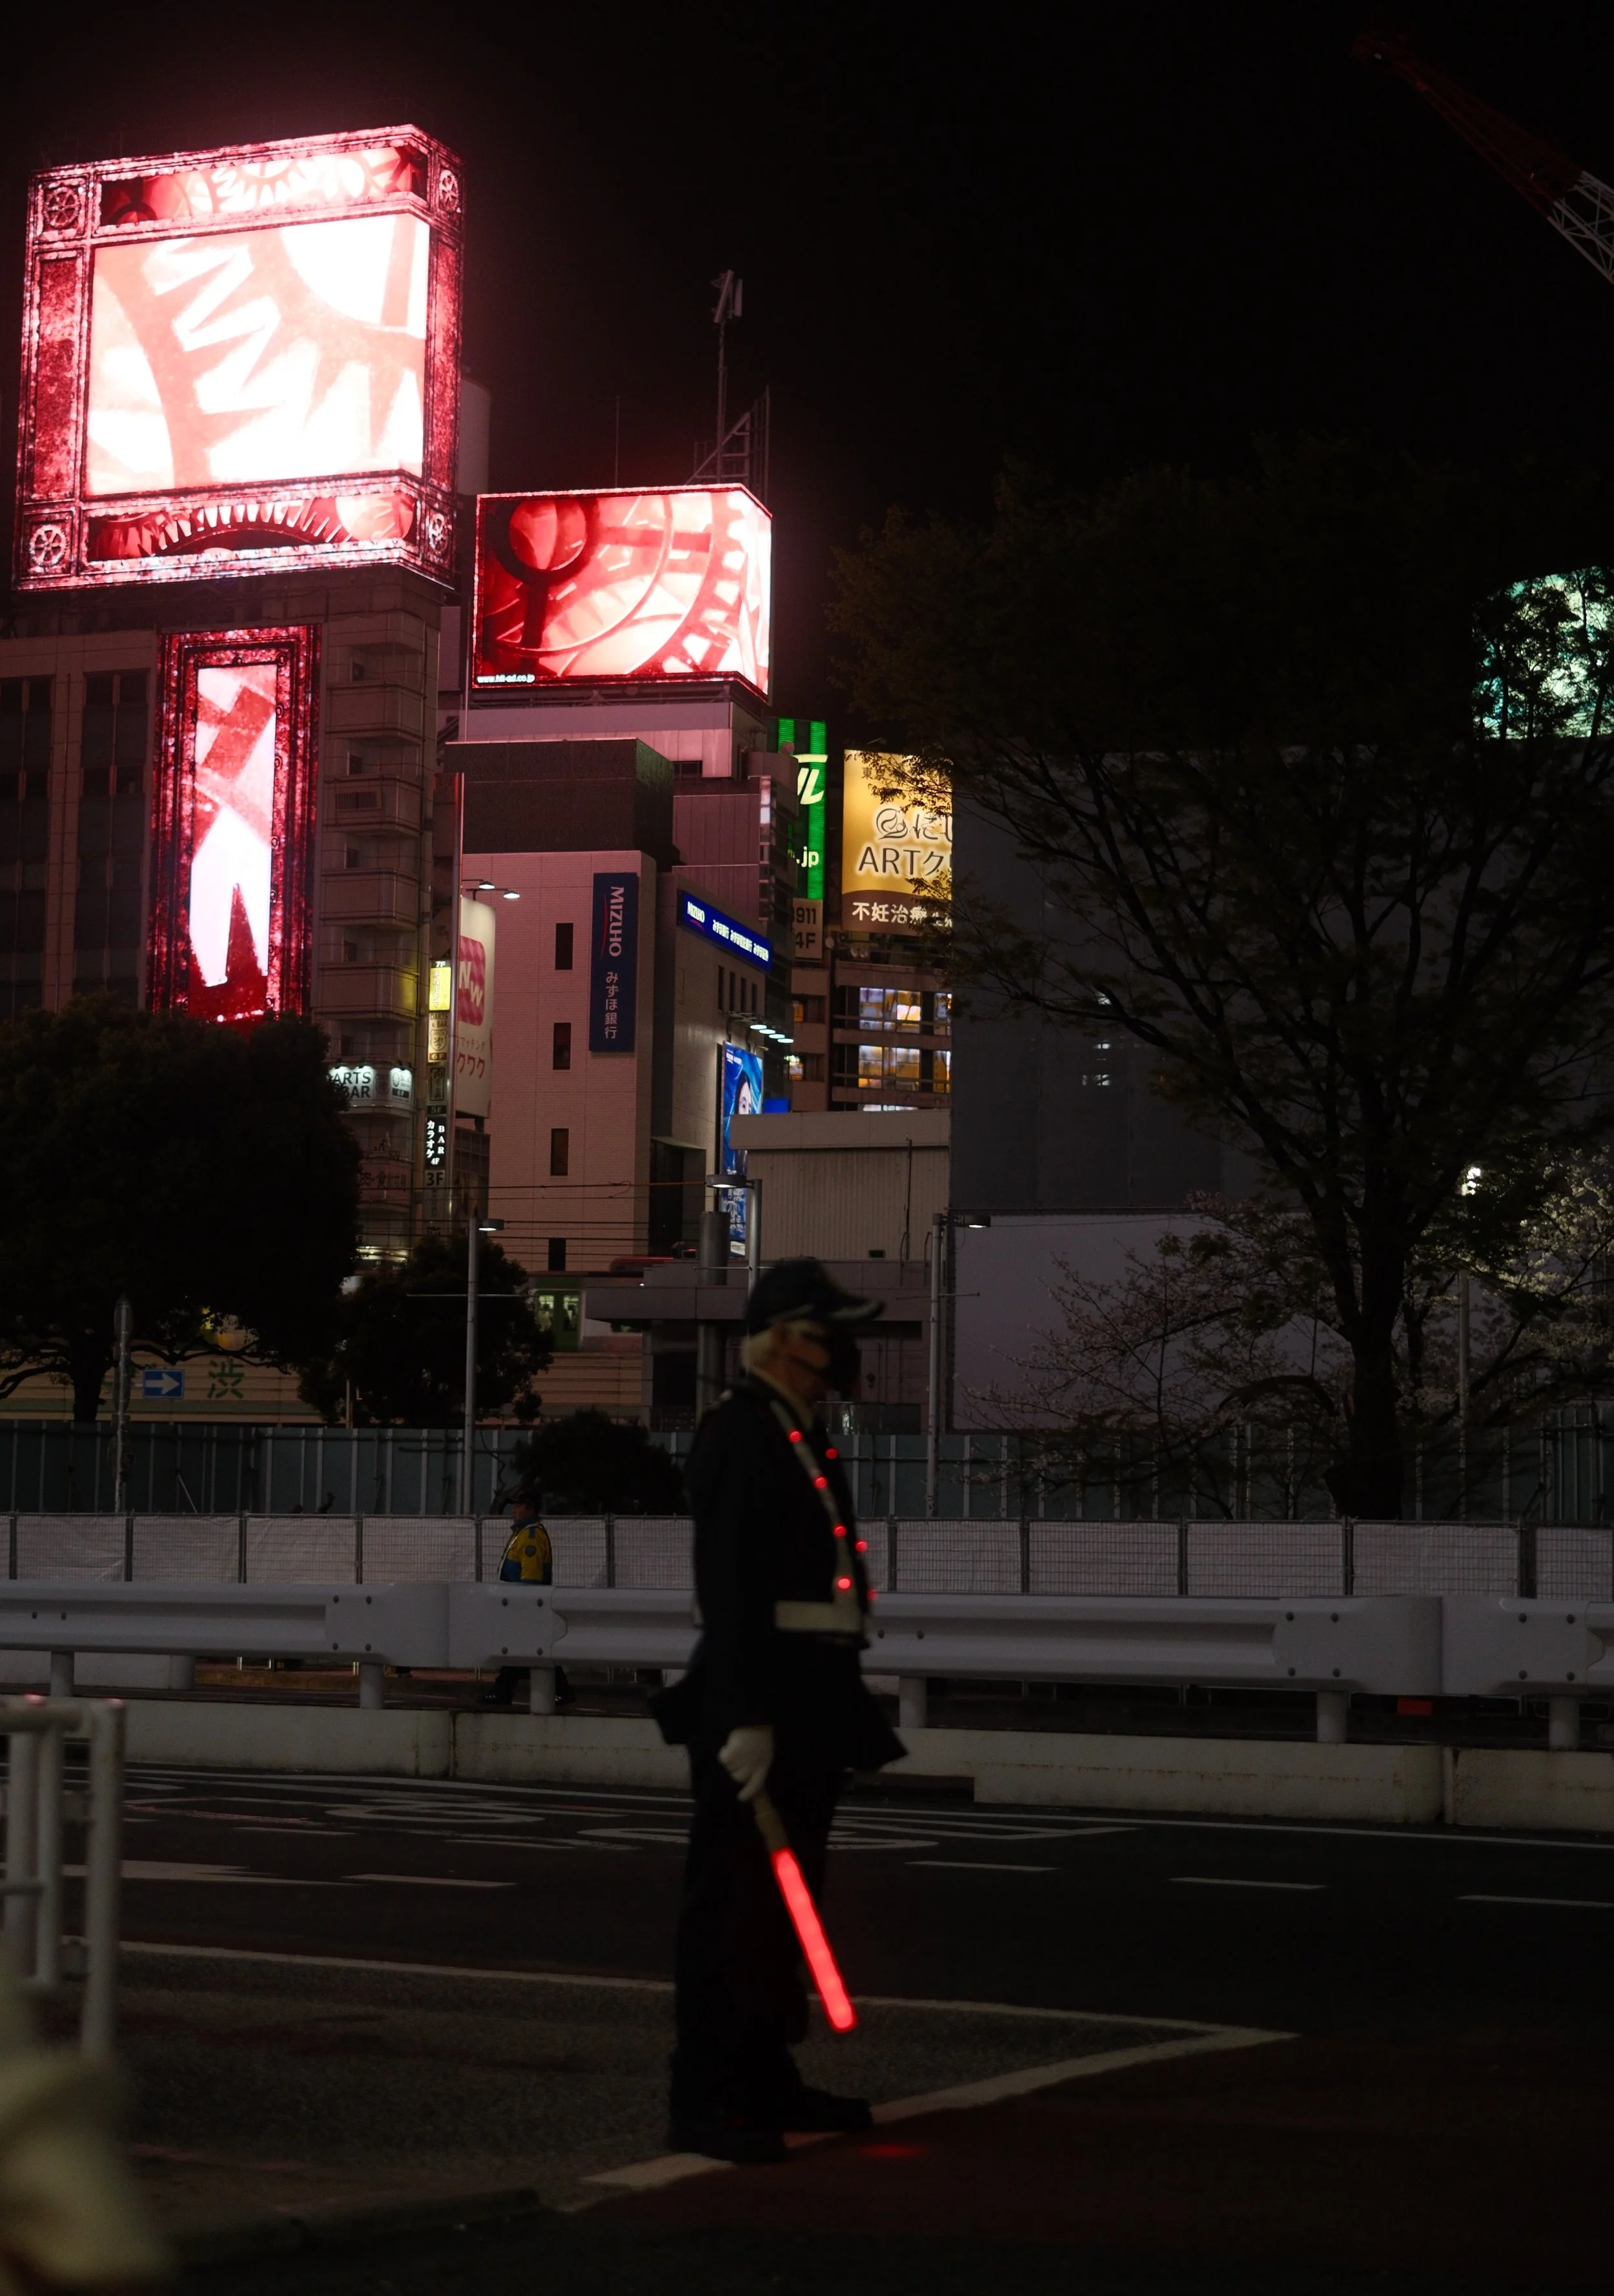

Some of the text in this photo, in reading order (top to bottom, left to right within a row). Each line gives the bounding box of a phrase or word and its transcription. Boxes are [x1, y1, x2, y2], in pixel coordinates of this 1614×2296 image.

[858, 846, 952, 876] ARTク
[609, 886, 624, 957] MIZUHO
[792, 908, 816, 924] 911
[604, 971, 619, 1039] みずほ銀行
[331, 1072, 371, 1085] ARTS
[426, 1120, 434, 1158] カラオケ
[427, 1172, 444, 1186] 3F
[209, 1359, 245, 1398] 渋
